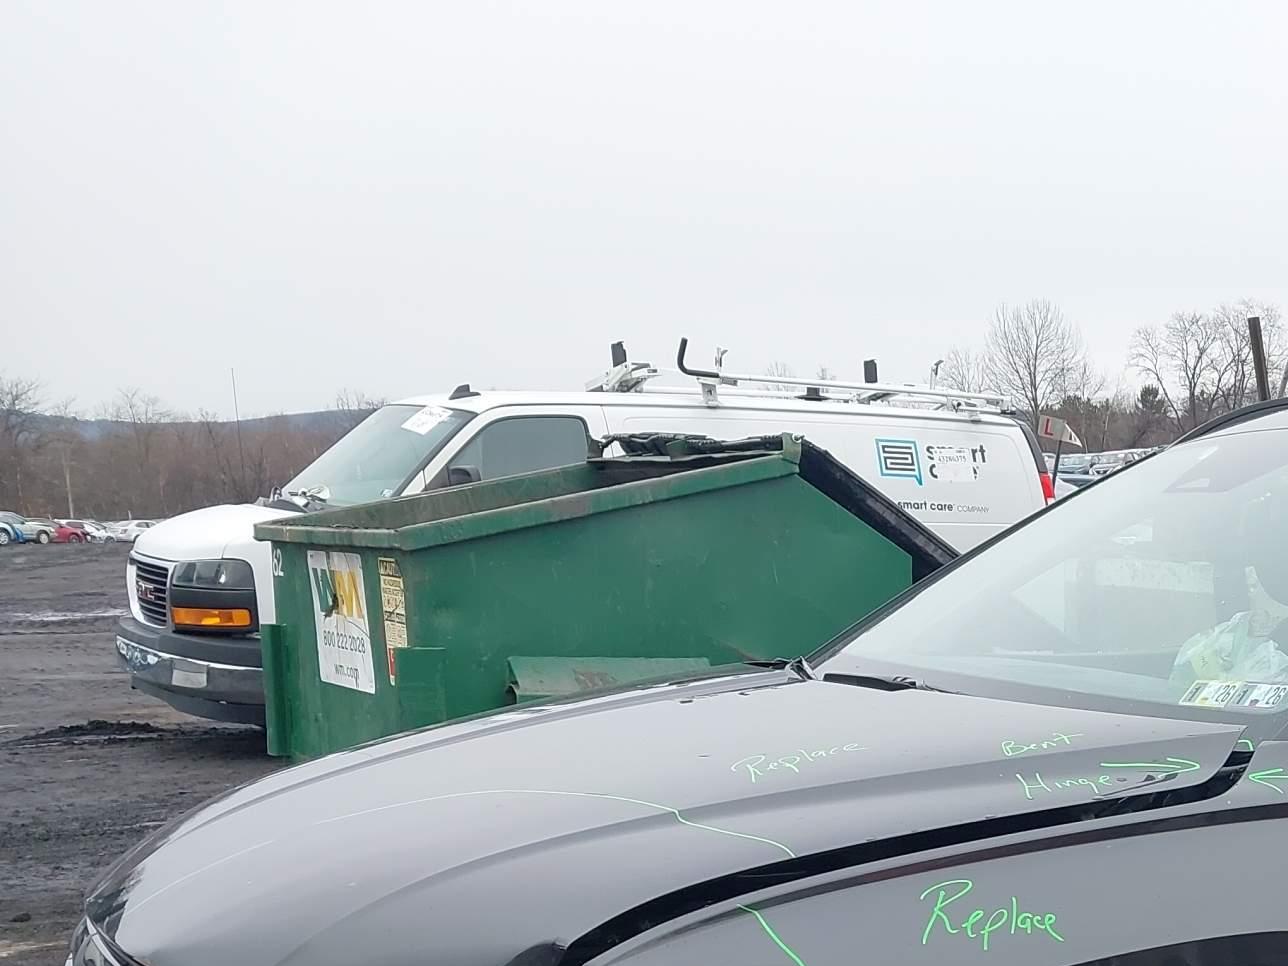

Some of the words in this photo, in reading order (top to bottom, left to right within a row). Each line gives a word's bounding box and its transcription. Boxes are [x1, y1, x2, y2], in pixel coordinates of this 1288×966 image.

[926, 445, 986, 464] srt
[897, 501, 927, 510] smart
[930, 503, 954, 511] care
[311, 567, 364, 619] WM
[323, 630, 336, 648] 800
[336, 632, 349, 651] 222
[919, 879, 1065, 951] Replace
